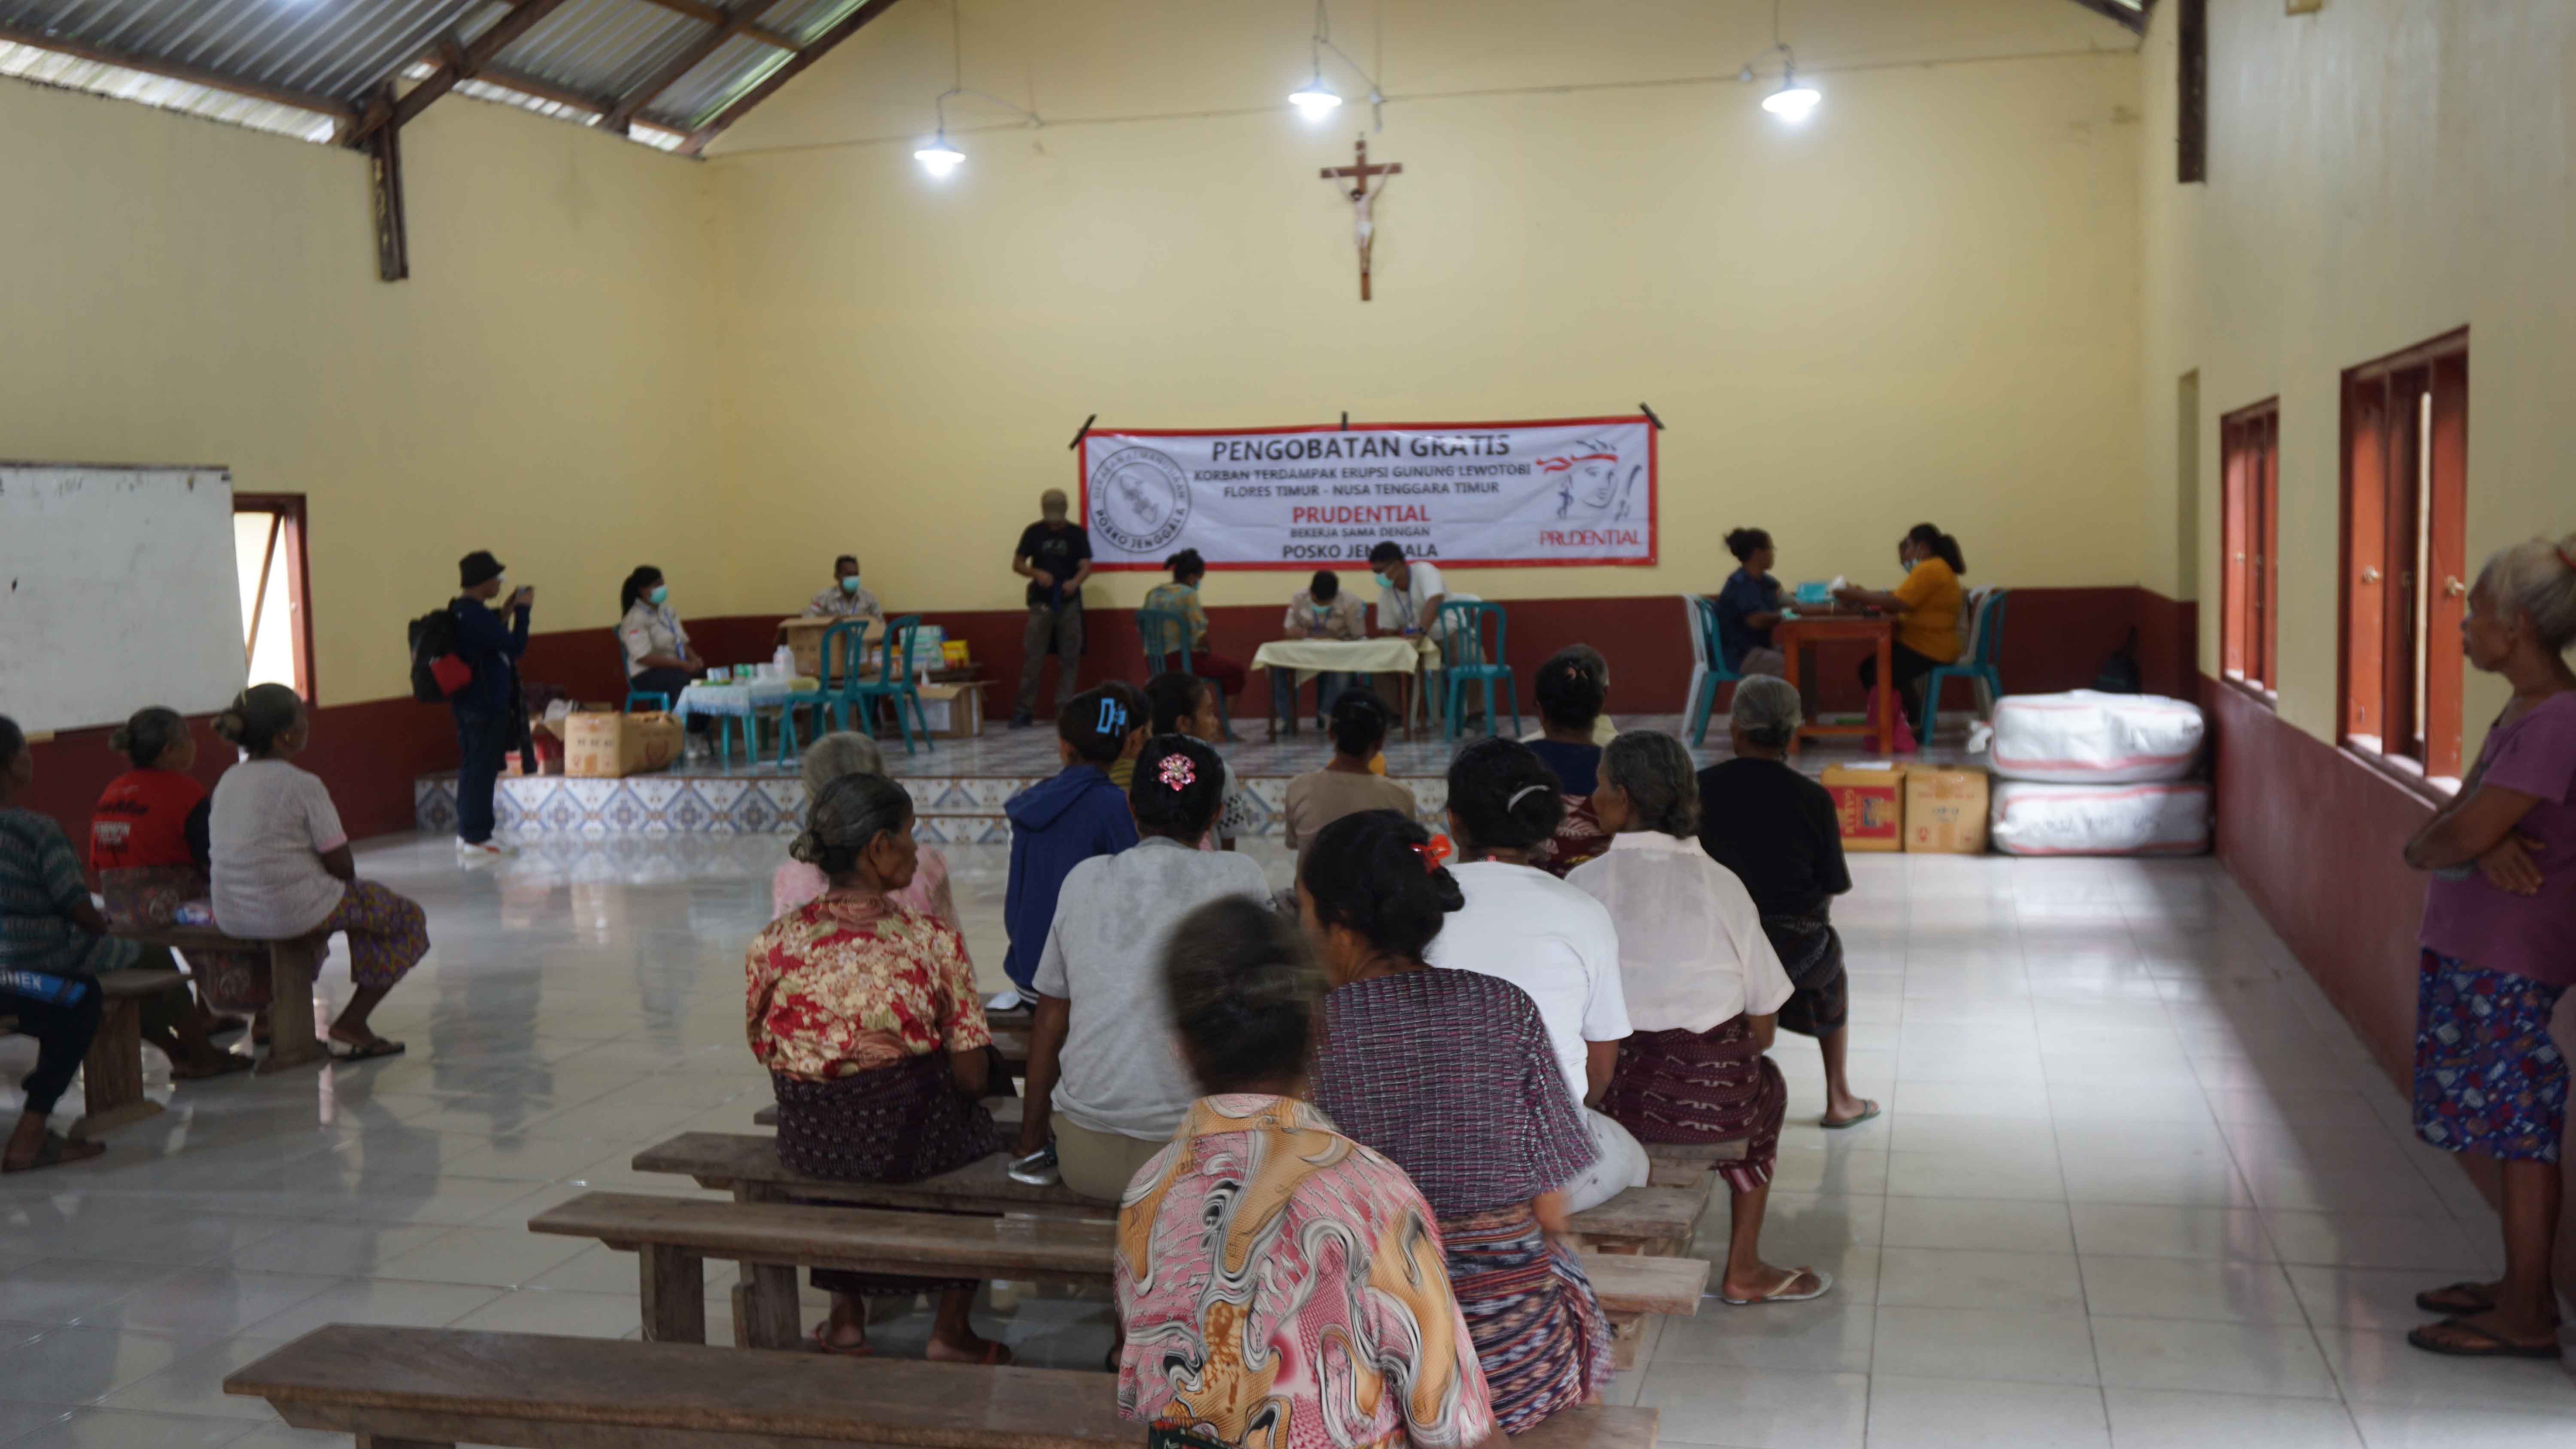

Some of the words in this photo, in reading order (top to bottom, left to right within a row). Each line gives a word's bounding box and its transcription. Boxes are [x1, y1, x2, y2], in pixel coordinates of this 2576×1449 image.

[1212, 436, 1401, 461] PENGOBATAN
[1410, 434, 1510, 457] GRATIS
[1194, 470, 1249, 481] KORBAN
[1253, 468, 1338, 480] TERDAMPAK
[1341, 466, 1389, 479] ERUPSI
[1393, 466, 1455, 478] GUNUNG
[1459, 463, 1531, 476] LEWOTOBI
[1224, 486, 1271, 497] FLORES
[1276, 485, 1319, 497] TIMUR
[1334, 484, 1371, 495] NUSA
[1375, 482, 1450, 495] TENGGARA
[1454, 481, 1500, 494] TIMUR
[1292, 504, 1431, 523] PRUDENTIAL
[1096, 509, 1127, 545] POSKO
[1131, 508, 1185, 549] JENGGALA
[1291, 527, 1338, 538] BEKERJA
[1343, 526, 1376, 538] SAMA
[1380, 526, 1431, 537] DENGAN
[1539, 528, 1642, 546] PRUDENTIAL
[1282, 544, 1341, 559] POSKO
[1347, 543, 1438, 559] JENALA
